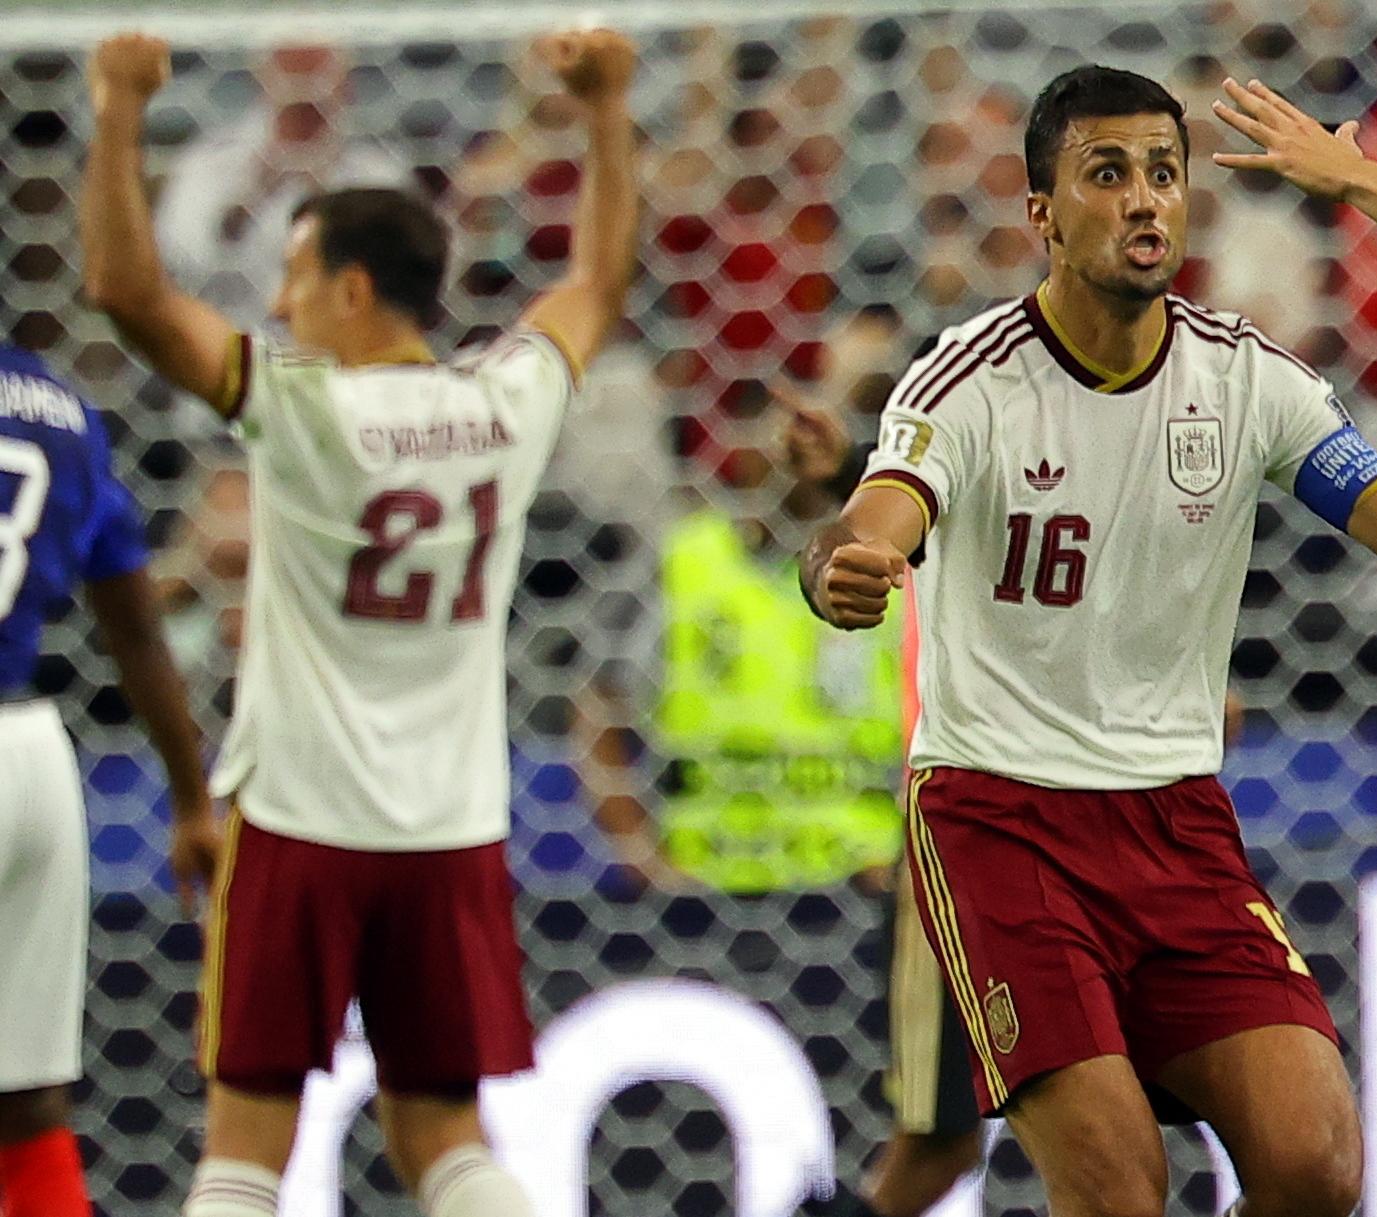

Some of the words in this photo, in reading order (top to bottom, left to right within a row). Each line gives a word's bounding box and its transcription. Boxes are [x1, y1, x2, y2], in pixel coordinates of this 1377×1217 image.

[1320, 440, 1372, 480] UNITE
[342, 481, 499, 623] 21
[993, 511, 1091, 608] 16
[1244, 902, 1313, 978] 1
